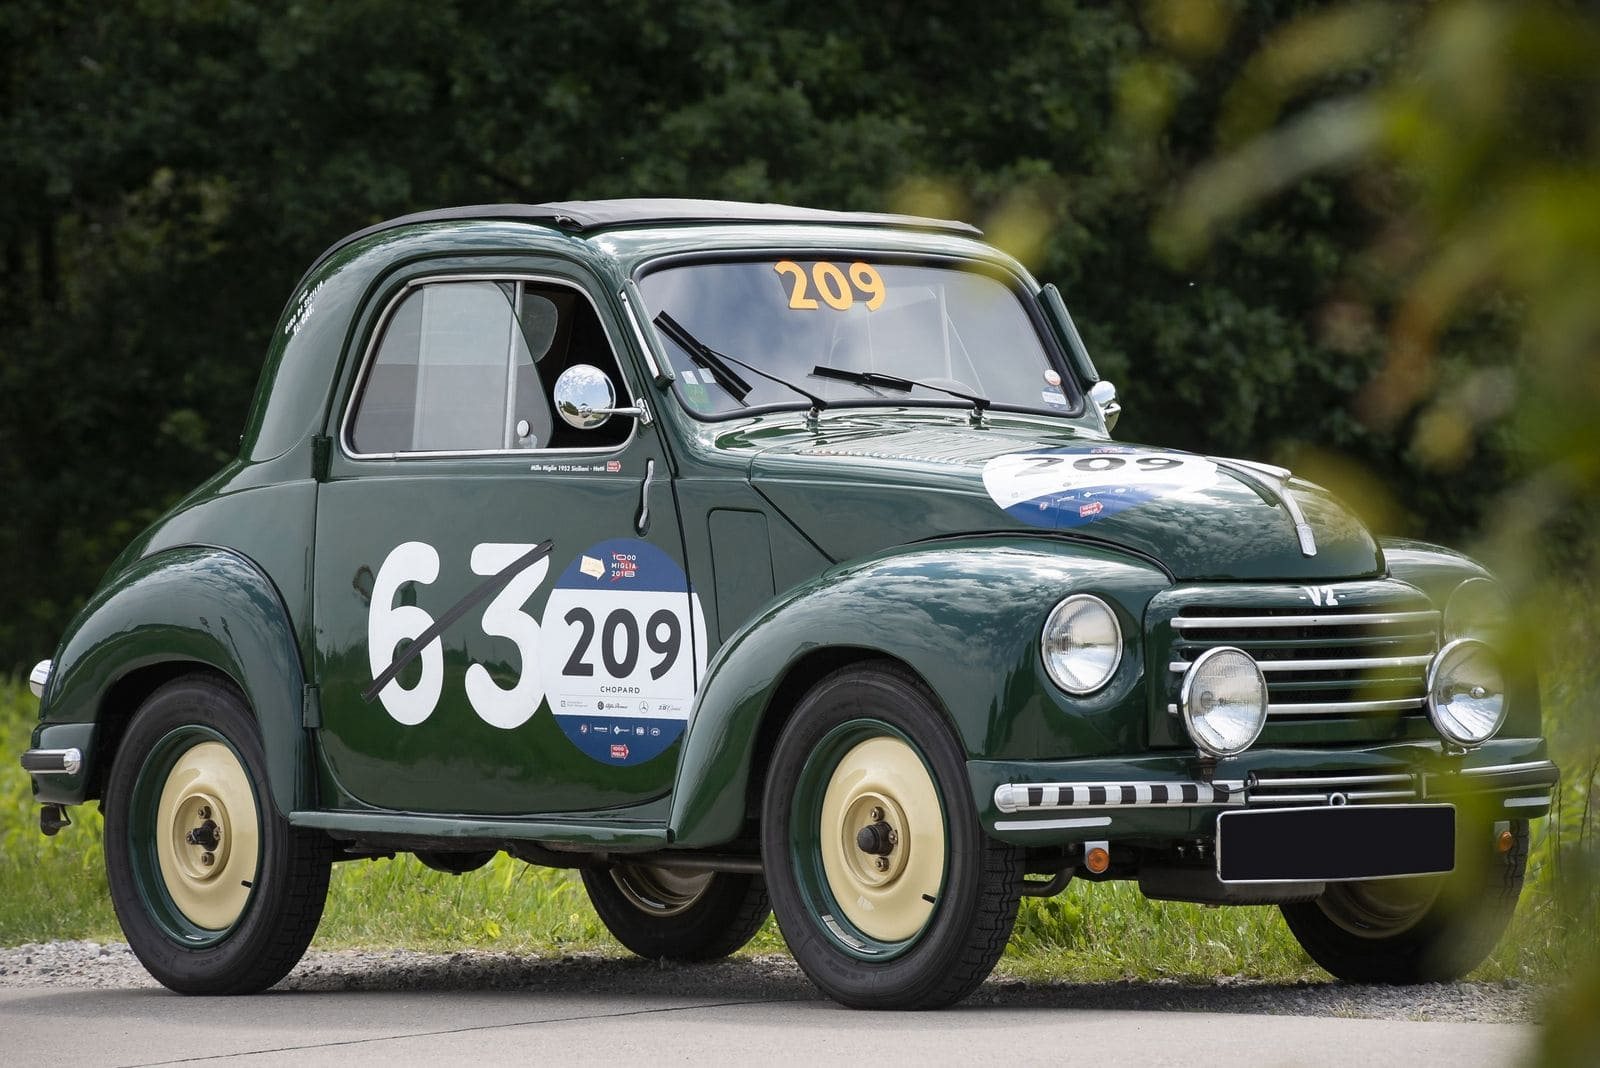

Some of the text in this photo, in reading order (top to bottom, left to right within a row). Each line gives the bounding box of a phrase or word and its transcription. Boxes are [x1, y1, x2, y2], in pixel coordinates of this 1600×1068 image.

[774, 260, 886, 312] 209
[542, 464, 557, 473] Miglia
[1014, 456, 1185, 477] 209
[368, 541, 550, 729] 63
[561, 606, 682, 681] 209
[600, 685, 641, 694] CHOPARD
